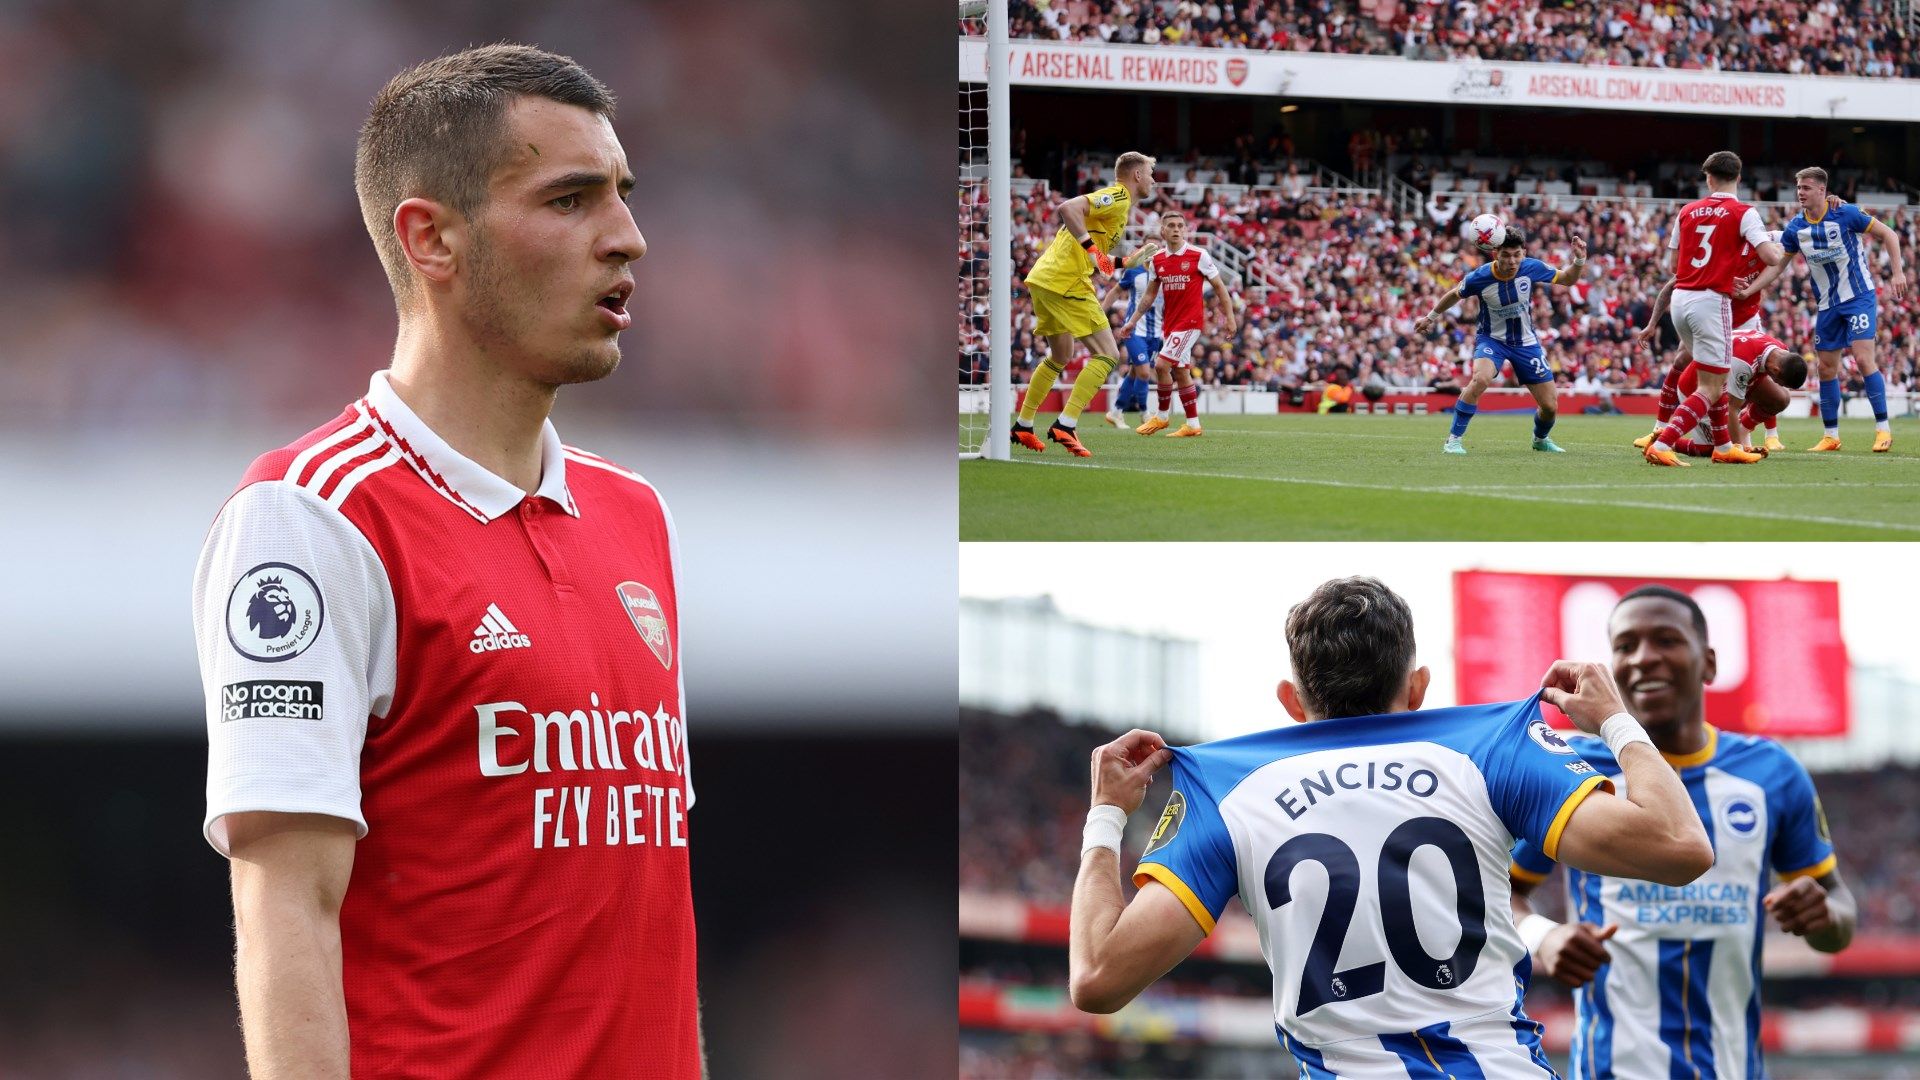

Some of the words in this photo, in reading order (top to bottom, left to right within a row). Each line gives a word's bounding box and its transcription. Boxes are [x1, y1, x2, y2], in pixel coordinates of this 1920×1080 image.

[1022, 51, 1114, 80] ARSENAL
[1122, 56, 1218, 85] REWARDS
[1690, 224, 1717, 269] 3
[1850, 313, 1870, 331] 28
[1166, 335, 1181, 349] 19
[266, 639, 298, 654] Premier
[297, 609, 313, 641] League
[469, 632, 532, 654] adidas
[222, 684, 249, 704] No
[252, 684, 312, 702] room
[250, 701, 322, 719] racism
[473, 692, 683, 777] Emirate
[1274, 761, 1439, 821] ENCISO
[533, 786, 591, 849] FLY
[606, 784, 687, 847] BETE
[1617, 883, 1748, 902] AMERICAN
[1263, 815, 1488, 1018] 20
[1637, 904, 1748, 925] EXPRESS
